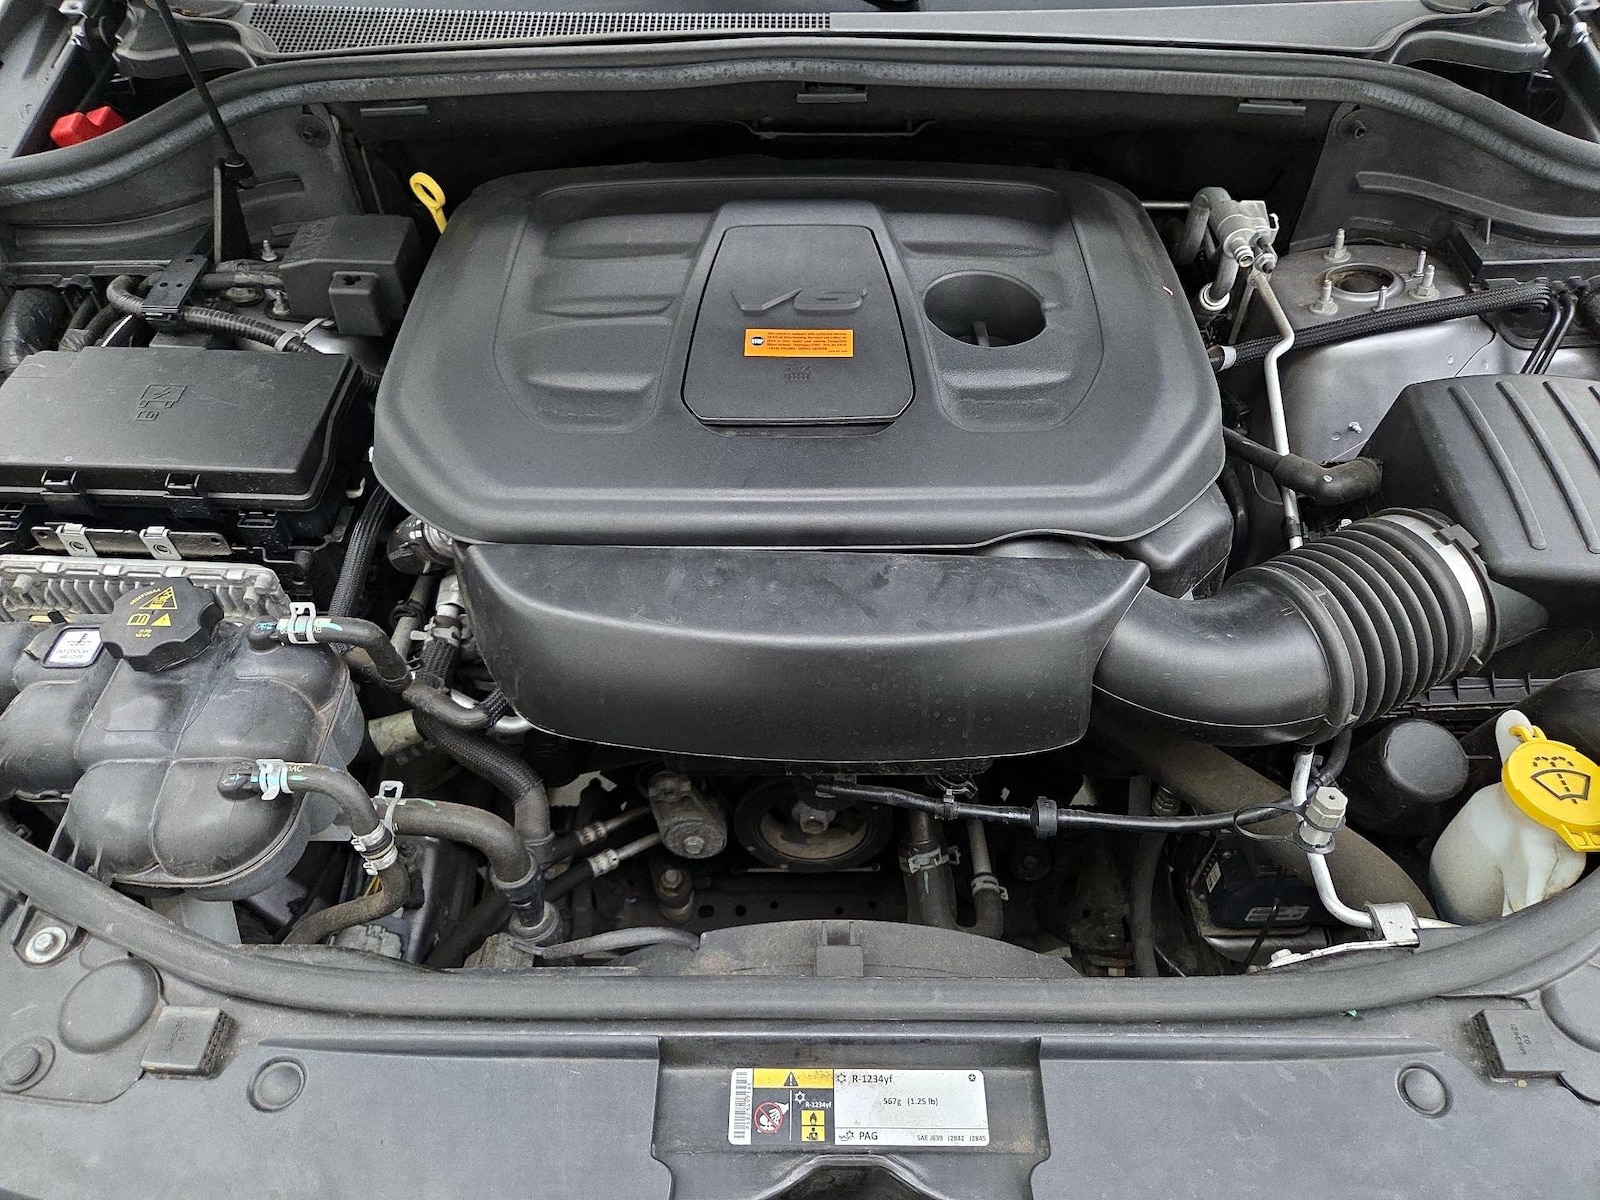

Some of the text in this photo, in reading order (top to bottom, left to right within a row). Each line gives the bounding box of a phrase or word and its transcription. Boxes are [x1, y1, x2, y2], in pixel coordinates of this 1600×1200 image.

[730, 287, 868, 313] V6
[852, 1074, 894, 1085] R-1234yf
[804, 1101, 832, 1110] R-1234yf
[883, 1097, 939, 1107] 567g (1.25 lb)
[859, 1131, 878, 1141] PAG
